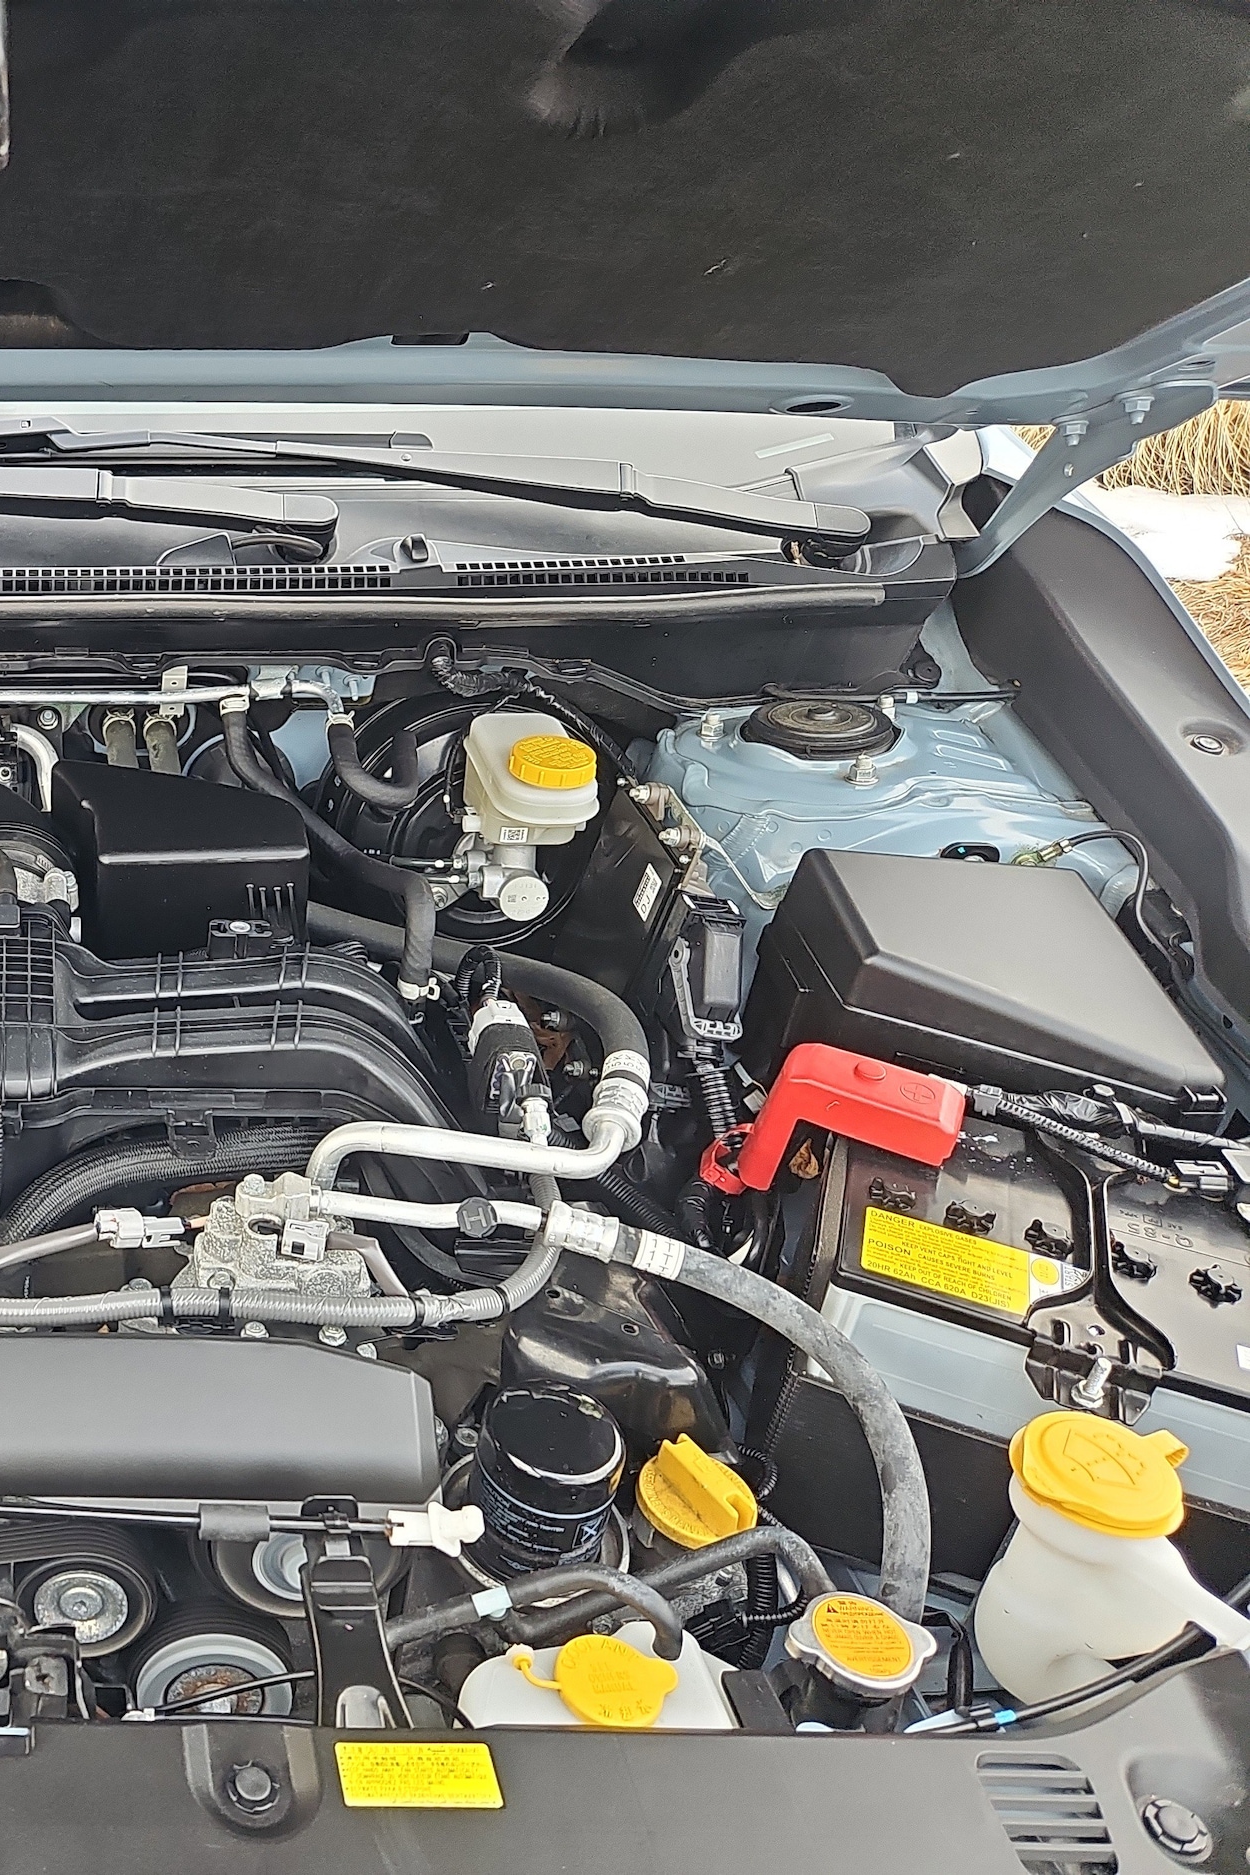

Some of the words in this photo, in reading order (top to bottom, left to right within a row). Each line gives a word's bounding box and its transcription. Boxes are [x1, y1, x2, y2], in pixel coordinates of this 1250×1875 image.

[462, 1207, 487, 1230] H
[870, 1210, 915, 1228] DANGER
[919, 1224, 953, 1239] EXPLOSIVE
[956, 1235, 977, 1245] GASES
[1127, 1222, 1194, 1248] Q-85
[868, 1238, 911, 1256] POISON
[918, 1254, 944, 1265] CAUSES
[946, 1261, 970, 1273] SEVERE
[973, 1270, 995, 1280] BURNS
[902, 1241, 918, 1249] KEEP
[920, 1246, 936, 1255] VENT
[938, 1250, 955, 1260] CAPS
[958, 1255, 976, 1267] TIGHT
[977, 1261, 991, 1271] AND
[992, 1265, 1013, 1278] LEVEL
[867, 1260, 891, 1272] 20HR
[893, 1268, 916, 1280] 62Ah
[921, 1276, 942, 1288] CCA
[943, 1284, 966, 1296] 620A
[899, 1263, 917, 1271] KEEP
[918, 1268, 931, 1277] OUT
[943, 1276, 966, 1287] REACH
[978, 1286, 1012, 1301] CHILDREN
